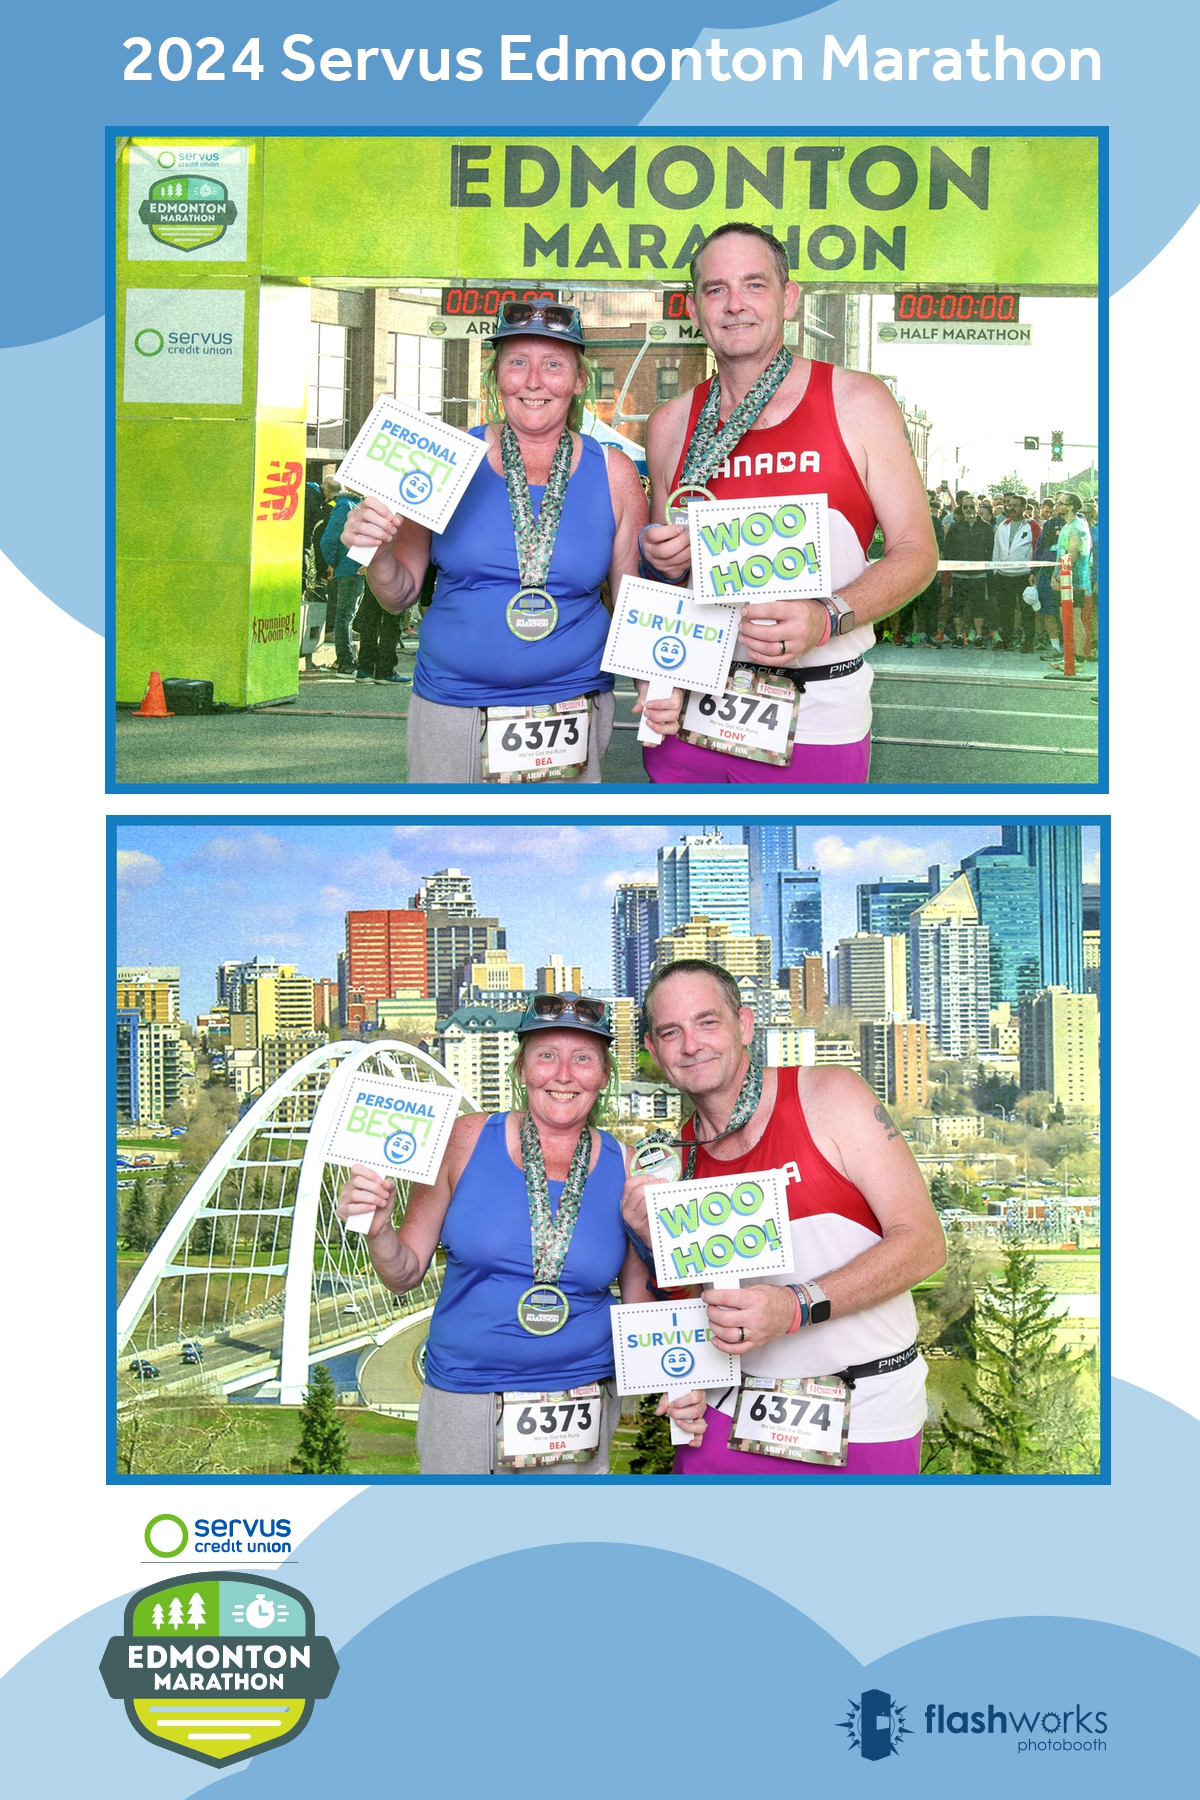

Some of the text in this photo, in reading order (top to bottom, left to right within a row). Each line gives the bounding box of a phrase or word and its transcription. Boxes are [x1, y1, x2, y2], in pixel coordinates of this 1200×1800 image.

[178, 153, 219, 161] servus
[450, 145, 990, 211] EDMONTON
[149, 203, 226, 214] EDMONTON
[160, 214, 215, 222] MARATHON
[523, 222, 906, 271] MARAHON
[168, 332, 233, 345] servus
[900, 328, 1031, 341] HALF MARATHON
[168, 345, 233, 355] credit union
[381, 419, 457, 466] PERSONAL
[365, 432, 454, 493] BEST!
[712, 451, 820, 479] ANADA
[700, 504, 807, 557] WOO
[709, 542, 820, 598] HOO!
[676, 600, 684, 615] I
[626, 609, 724, 644] SURVIVED!
[698, 694, 779, 731] 6374
[501, 717, 579, 752] 6373
[711, 740, 749, 755] ARMY 10K
[719, 729, 746, 741] TONY
[535, 757, 552, 766] BEA
[526, 771, 546, 780] ARMY
[355, 1092, 436, 1118] PERSONAL
[345, 1105, 433, 1147] BEST!
[657, 1181, 764, 1239] WOO
[670, 1218, 781, 1279] HOO!
[672, 1313, 678, 1326] I
[516, 1403, 592, 1435] 6373
[749, 1394, 831, 1432] 6374
[549, 1441, 566, 1450] BEA
[764, 1445, 786, 1455] ARMY
[771, 1432, 799, 1443] TONY
